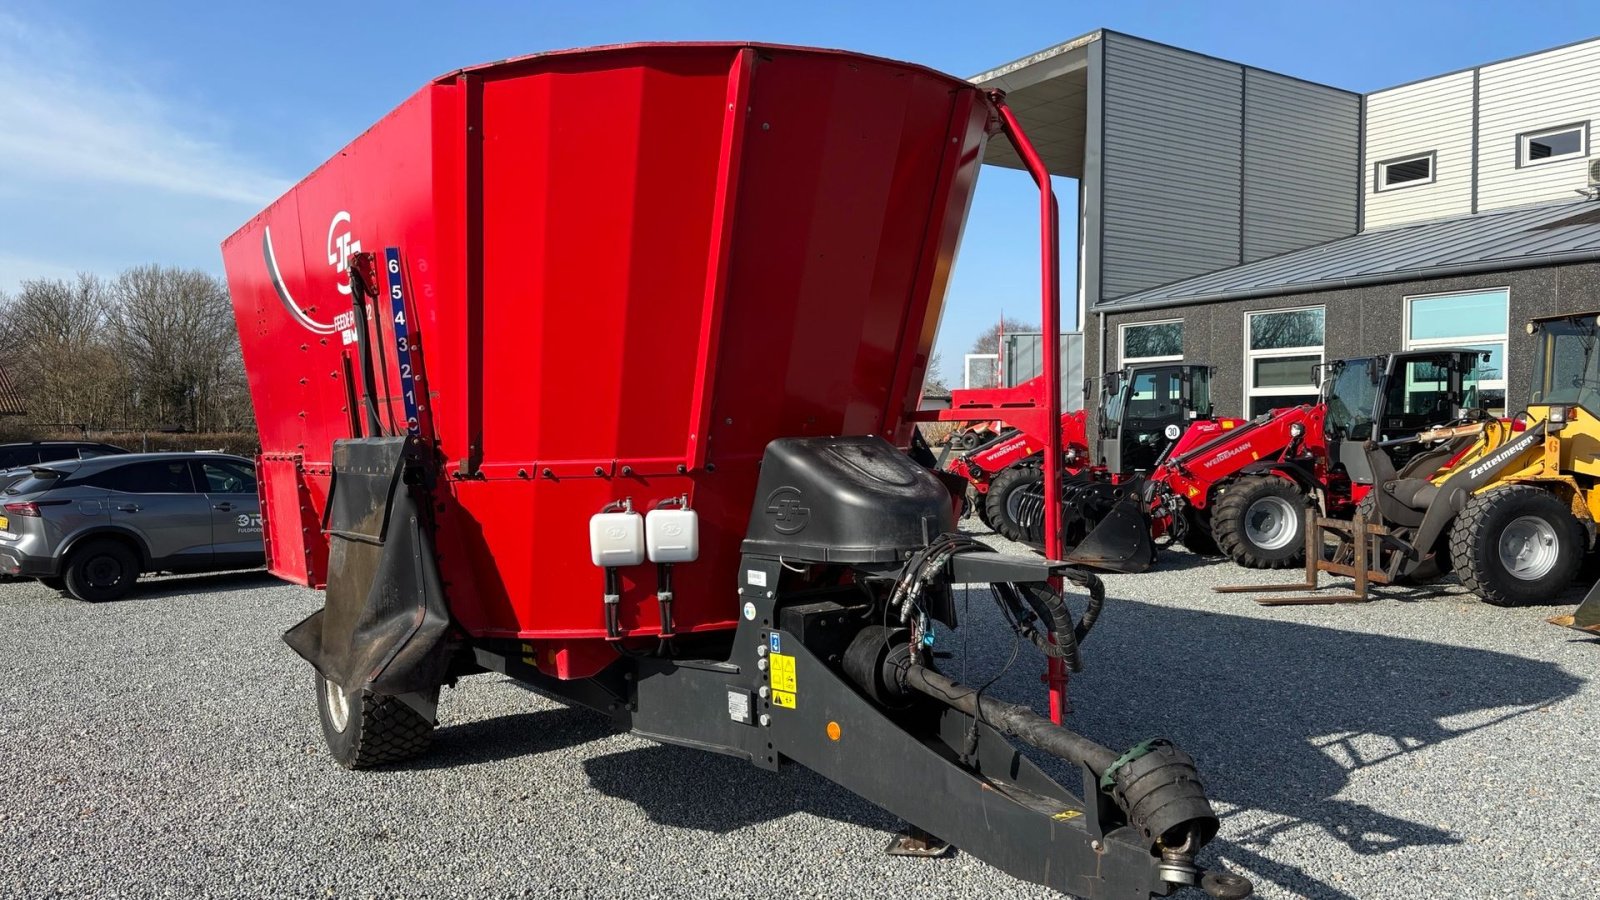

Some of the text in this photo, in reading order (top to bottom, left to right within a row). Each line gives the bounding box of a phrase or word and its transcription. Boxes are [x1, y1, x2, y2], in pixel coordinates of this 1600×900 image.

[388, 259, 399, 273] 6
[392, 284, 403, 299] 5
[395, 310, 406, 326] 4
[398, 337, 409, 352] 3
[401, 364, 412, 379] 2
[406, 390, 414, 405] 1
[1167, 427, 1178, 437] 30
[986, 440, 1026, 461] WEIDEMANN
[1203, 442, 1252, 468] WEIDEMANN
[1469, 435, 1534, 479] Zettelmeyer
